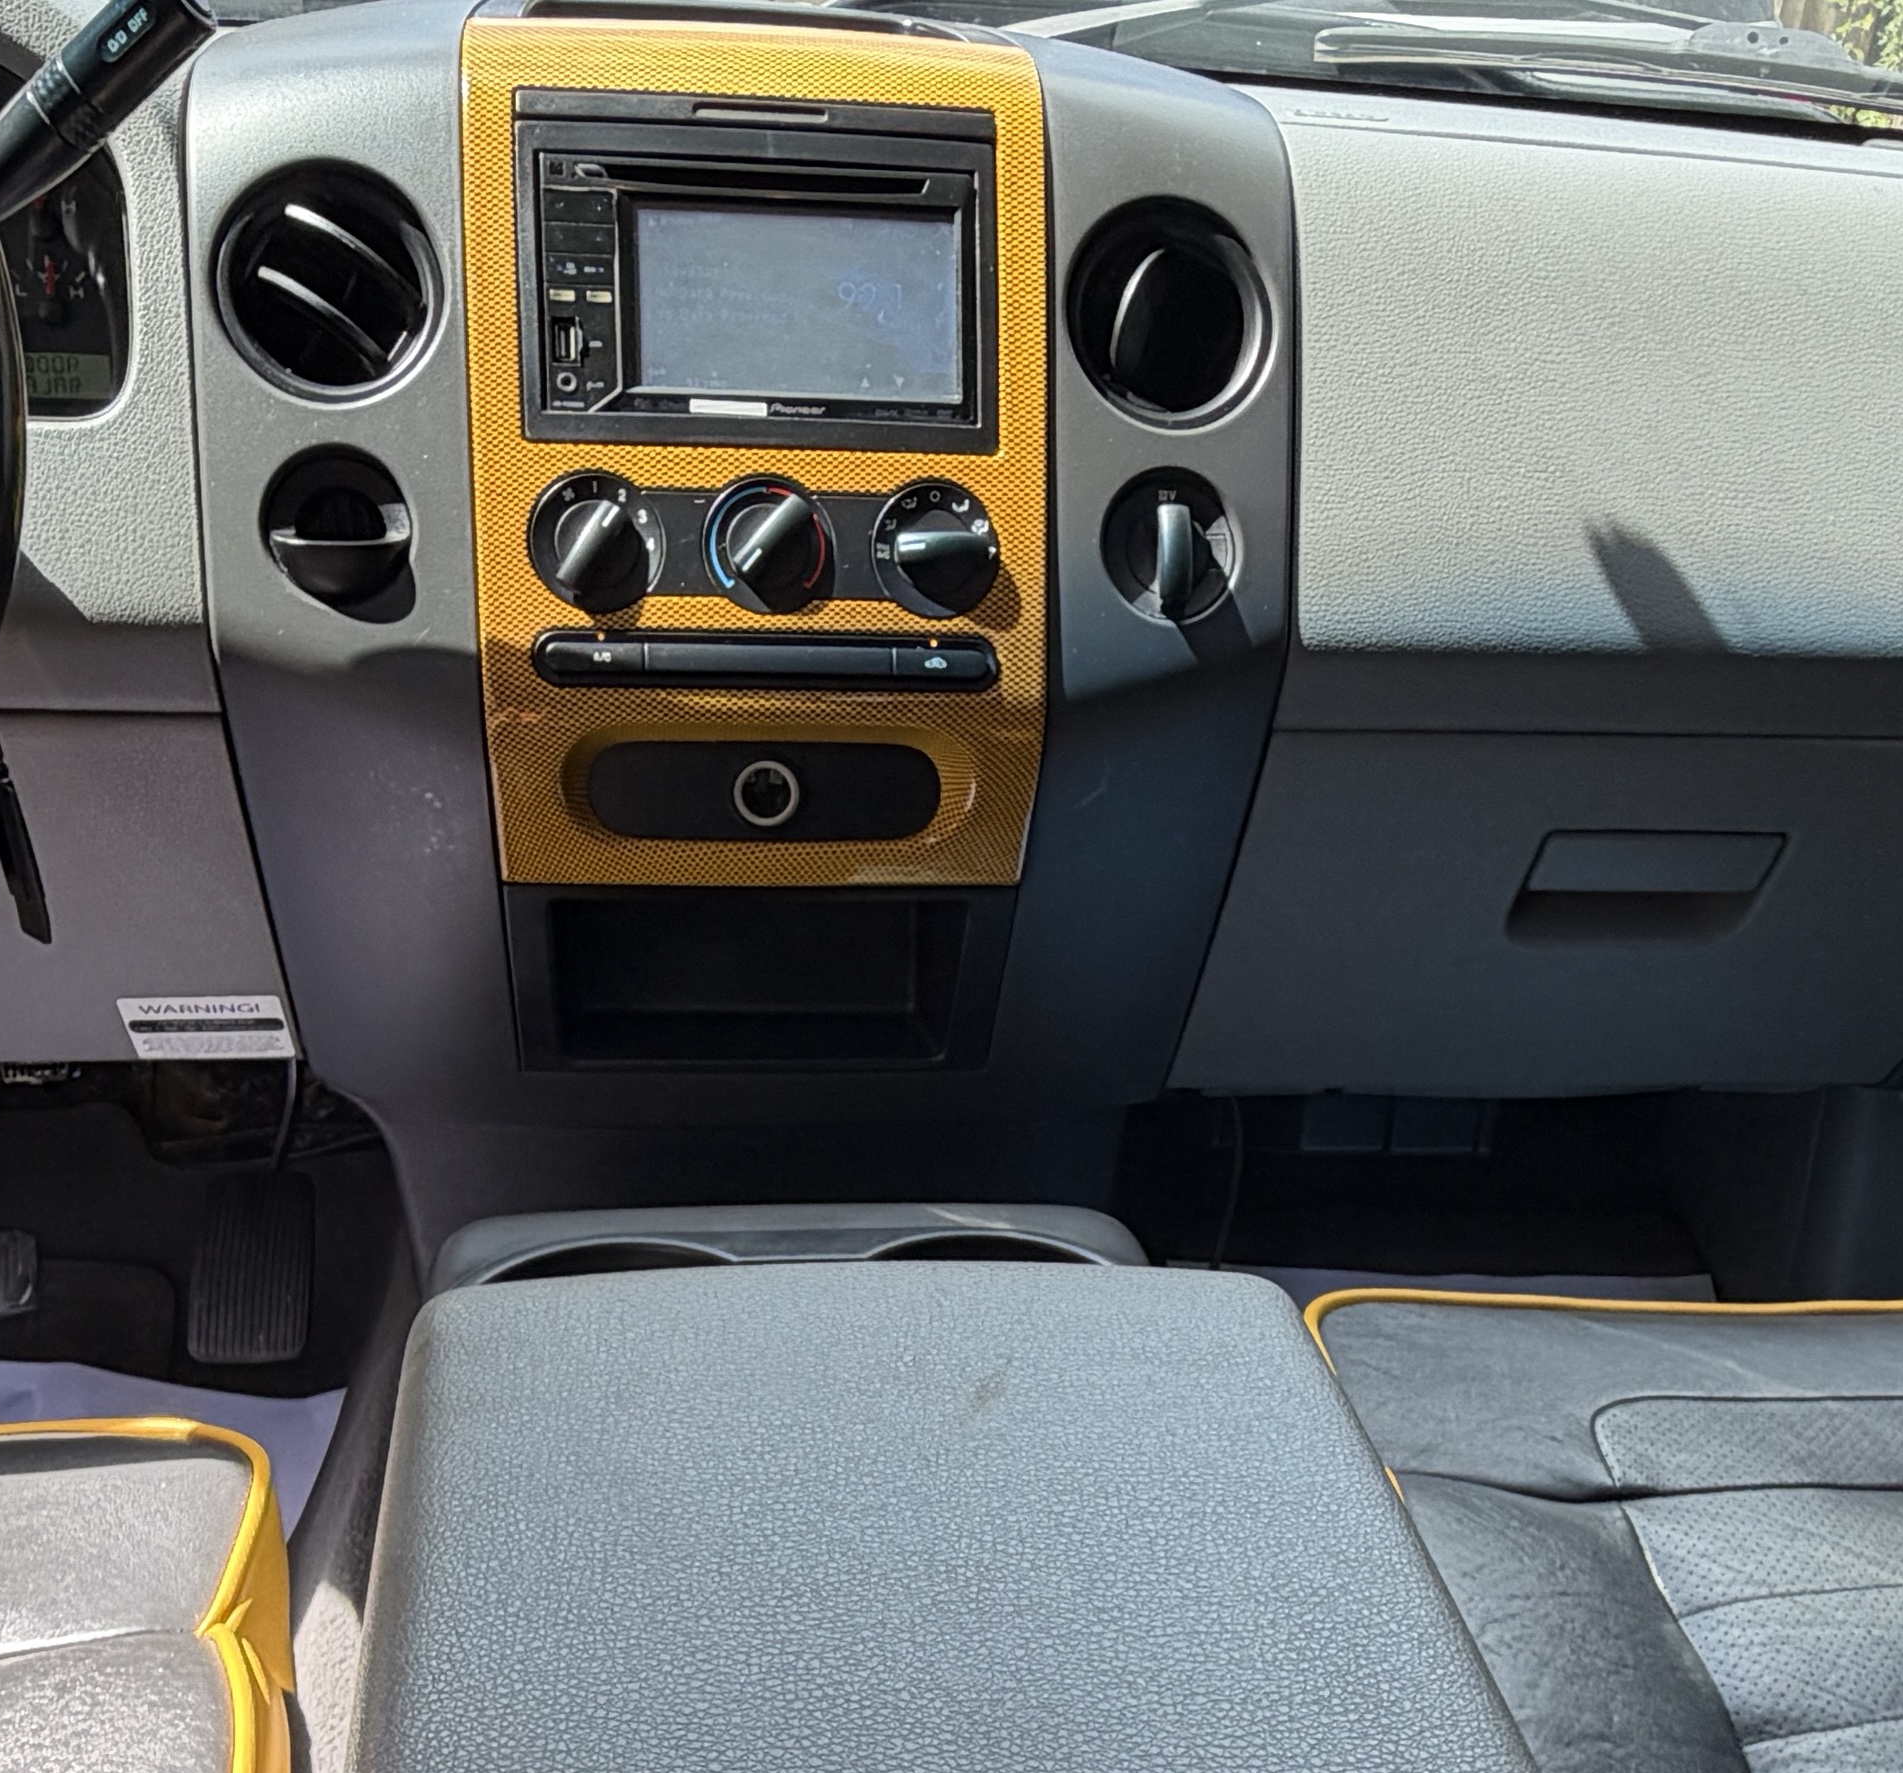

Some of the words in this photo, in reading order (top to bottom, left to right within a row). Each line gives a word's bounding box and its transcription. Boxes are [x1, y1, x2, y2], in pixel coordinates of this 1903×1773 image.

[127, 7, 148, 33] OFF
[617, 488, 628, 503] 2
[637, 508, 648, 524] 3
